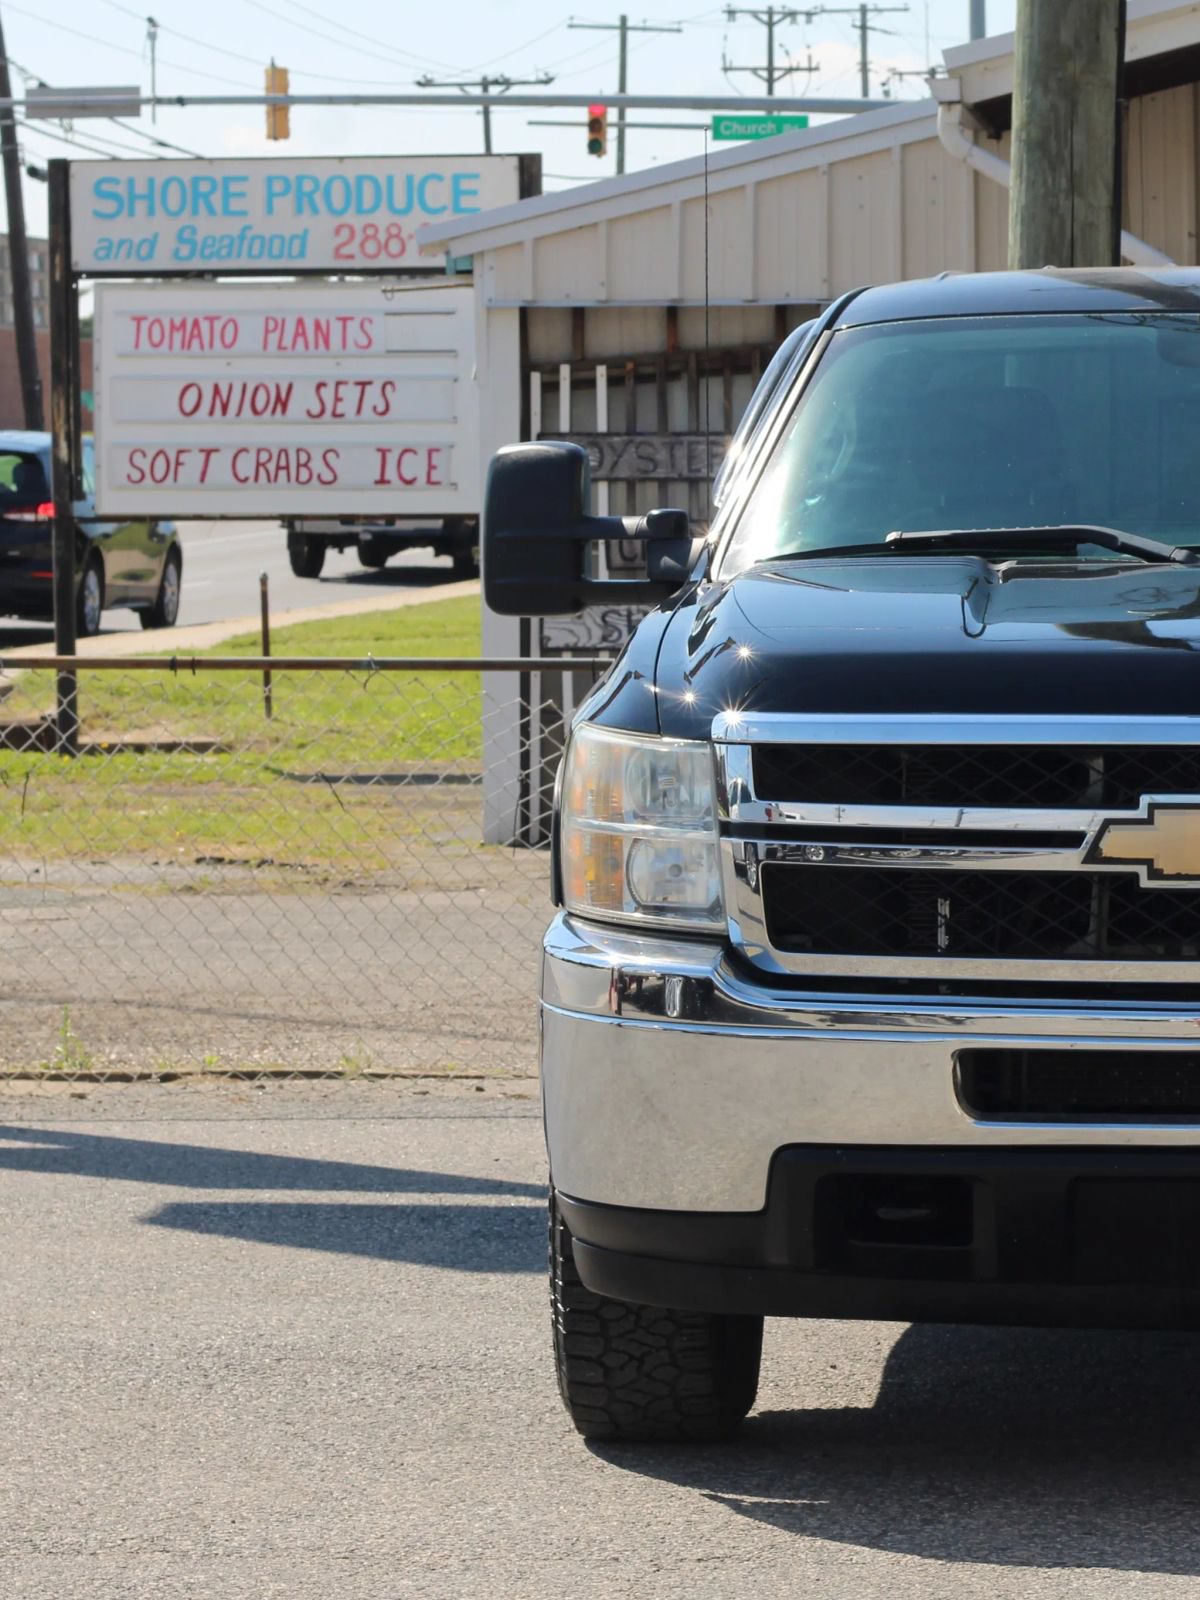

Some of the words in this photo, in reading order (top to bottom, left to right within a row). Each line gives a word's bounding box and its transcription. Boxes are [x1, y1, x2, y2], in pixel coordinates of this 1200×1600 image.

[720, 120, 777, 136] Church
[92, 174, 250, 219] SHORE
[265, 172, 481, 216] PRODUCE
[93, 231, 159, 262] and
[172, 223, 310, 262] Seafood
[130, 315, 240, 351] TOMATO
[261, 315, 374, 352] PLANTS
[177, 380, 294, 418] ONION
[305, 379, 396, 419] SETS
[126, 447, 221, 485] SOFT
[231, 447, 341, 486] CRABS
[373, 447, 442, 486] ICE
